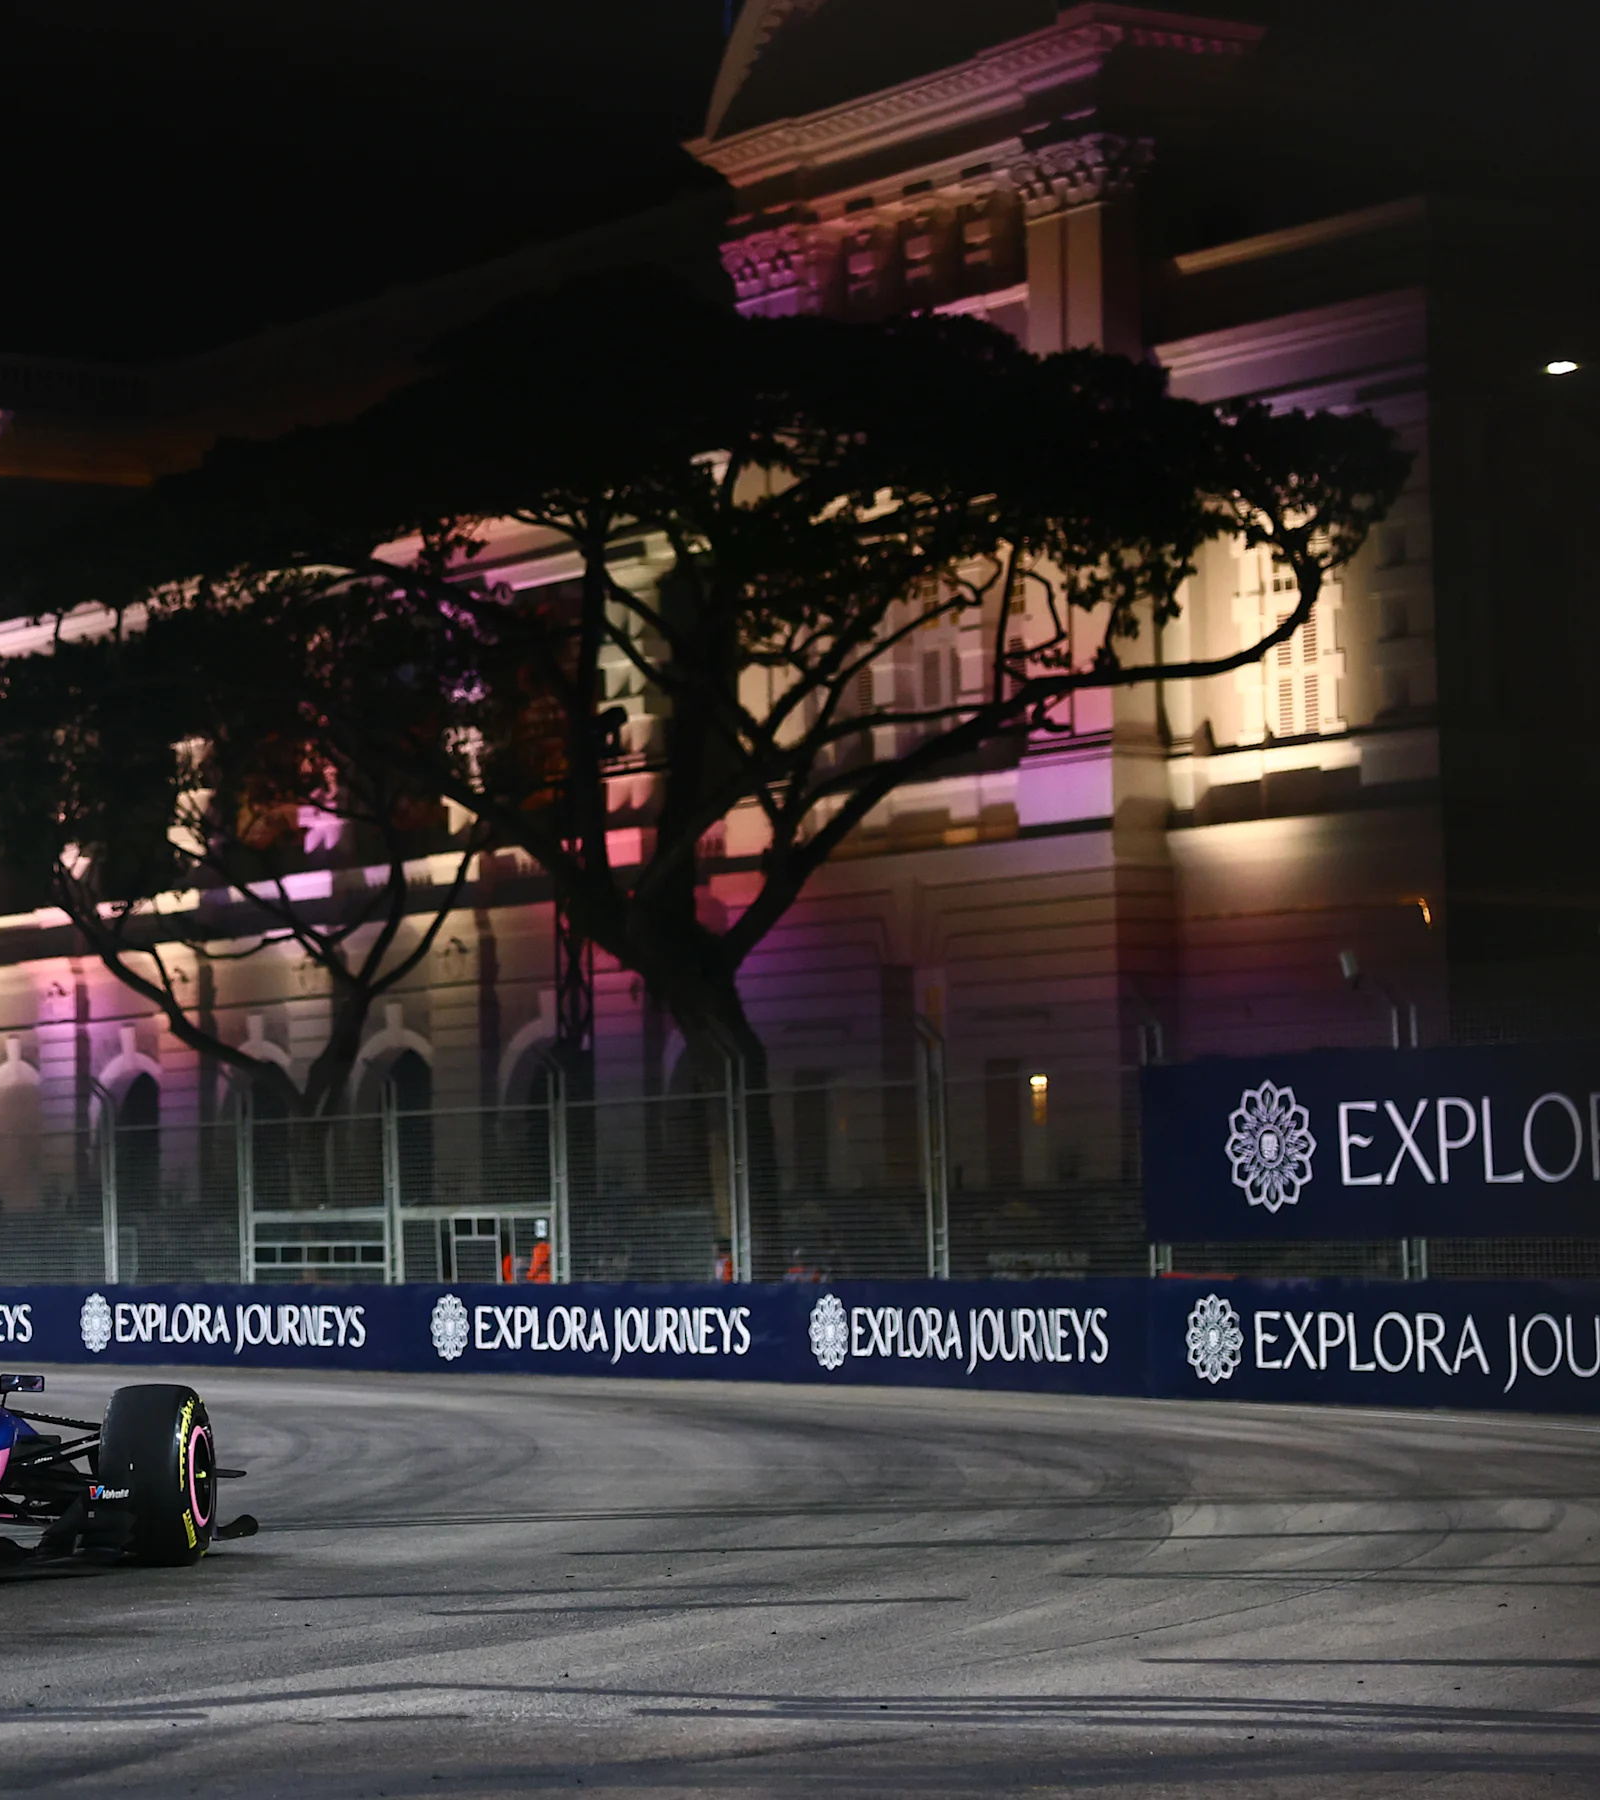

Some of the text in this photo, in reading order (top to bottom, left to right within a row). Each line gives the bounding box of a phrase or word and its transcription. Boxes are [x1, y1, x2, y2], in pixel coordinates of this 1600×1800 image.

[1337, 1092, 1600, 1187] EXPLO
[114, 1302, 367, 1355] EXPLORA JOURNEYS
[474, 1305, 751, 1365] EXPLORA JOURNEYS
[850, 1307, 1109, 1375] EXPLORA JOURNEYS
[1254, 1310, 1490, 1376] EXPLORA
